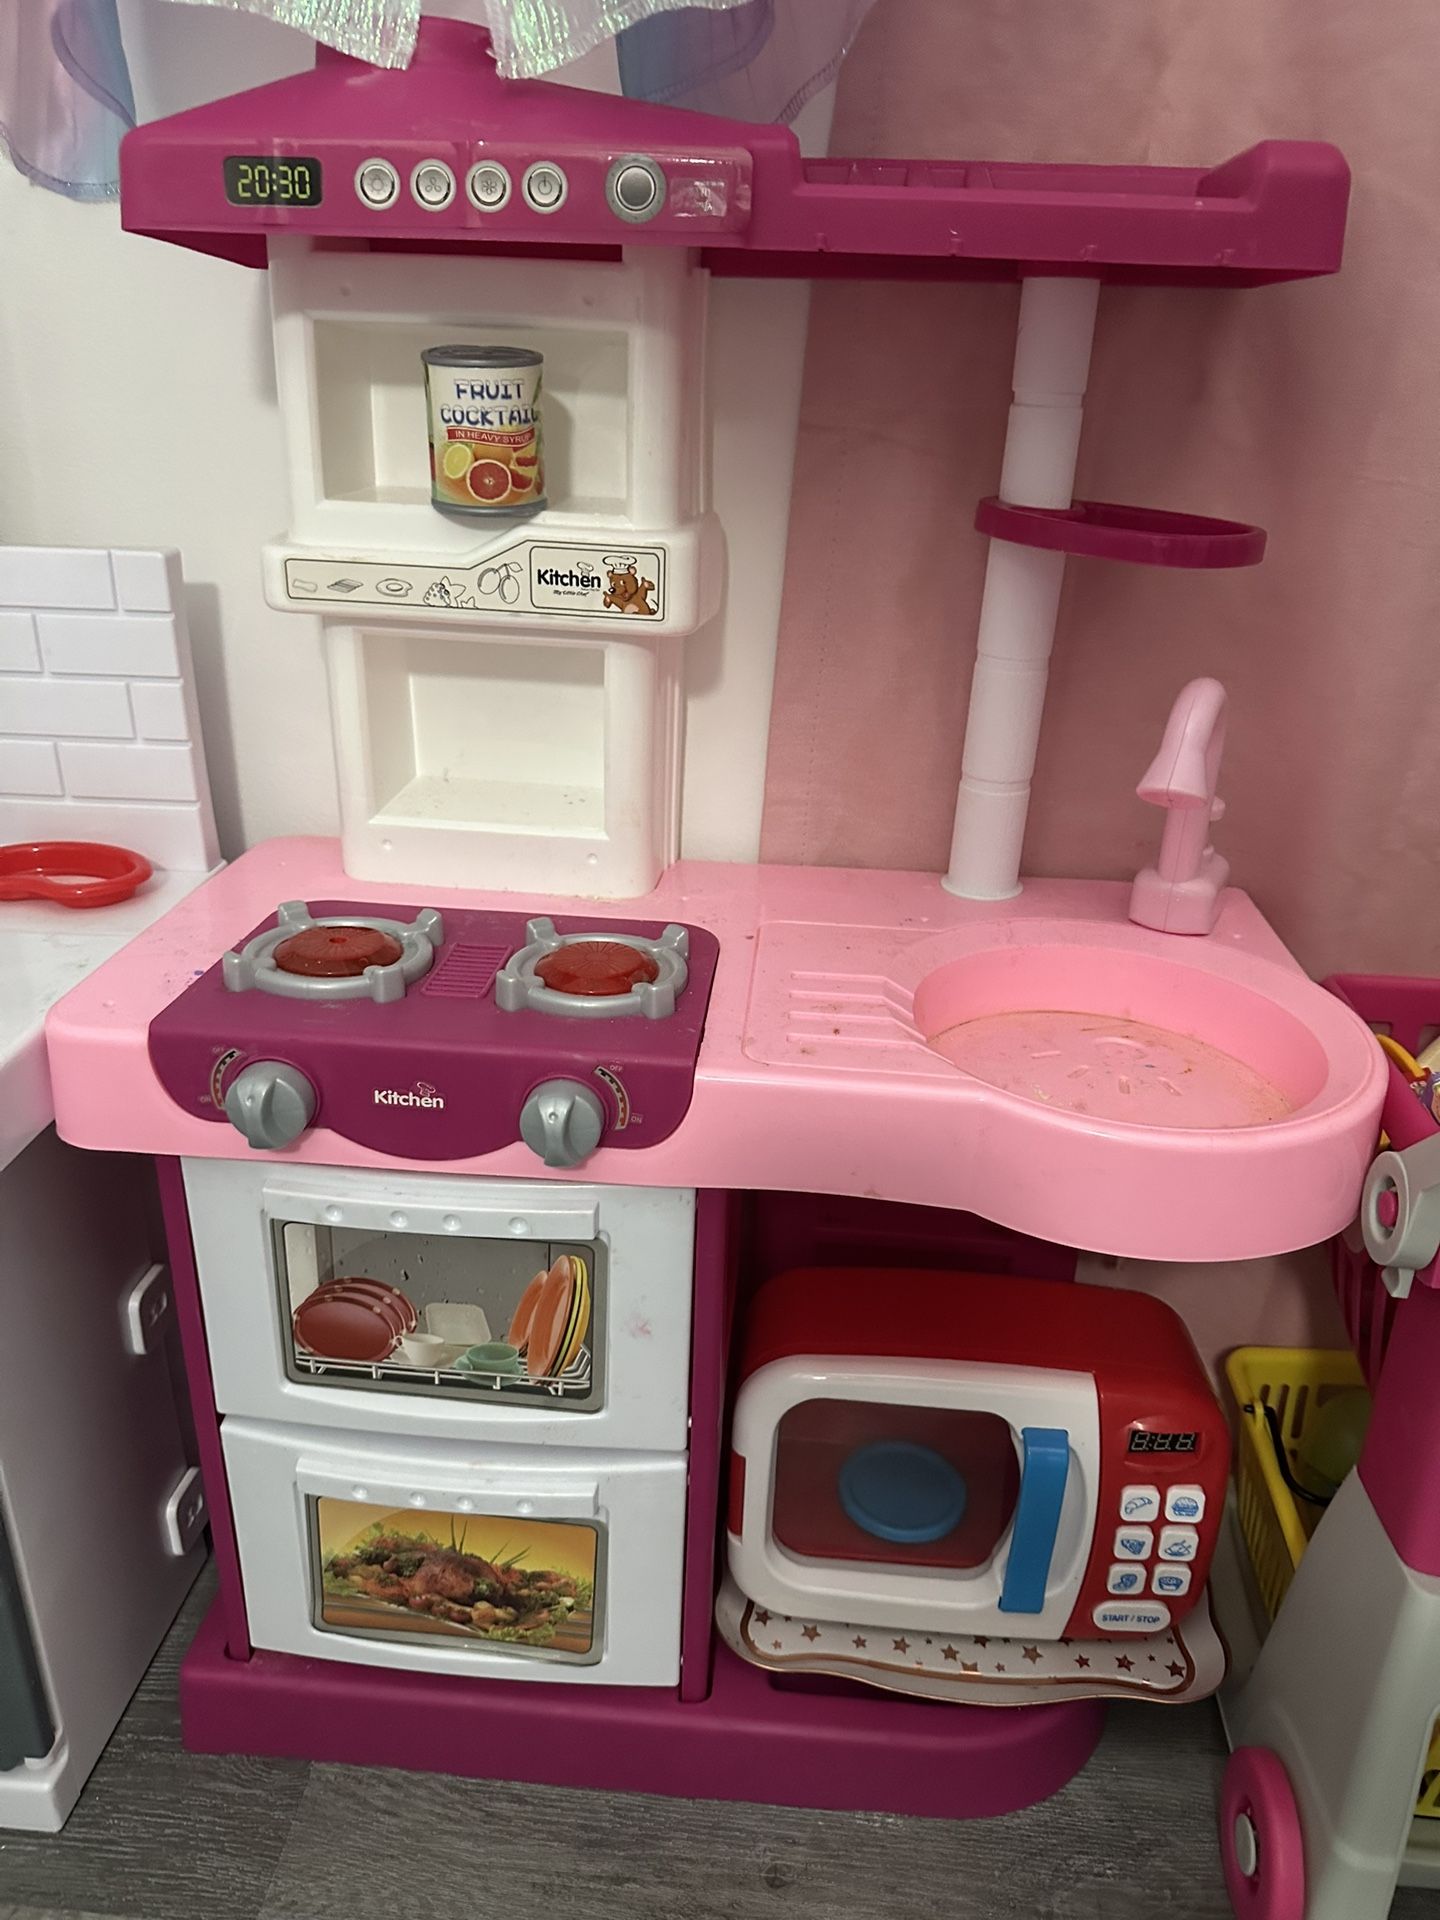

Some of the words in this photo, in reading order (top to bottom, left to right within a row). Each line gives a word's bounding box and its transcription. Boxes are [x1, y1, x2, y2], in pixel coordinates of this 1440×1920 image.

[238, 164, 310, 199] 20:30
[454, 378, 524, 400] FRUIT
[440, 403, 538, 426] COCKTAIL
[455, 430, 465, 438] IN
[467, 431, 500, 442] HEAVY
[502, 433, 532, 443] SYRUP
[537, 568, 601, 589] Kitchen
[374, 1089, 444, 1109] Kitchen
[1102, 1614, 1129, 1623] START
[1136, 1615, 1161, 1624] STOP
